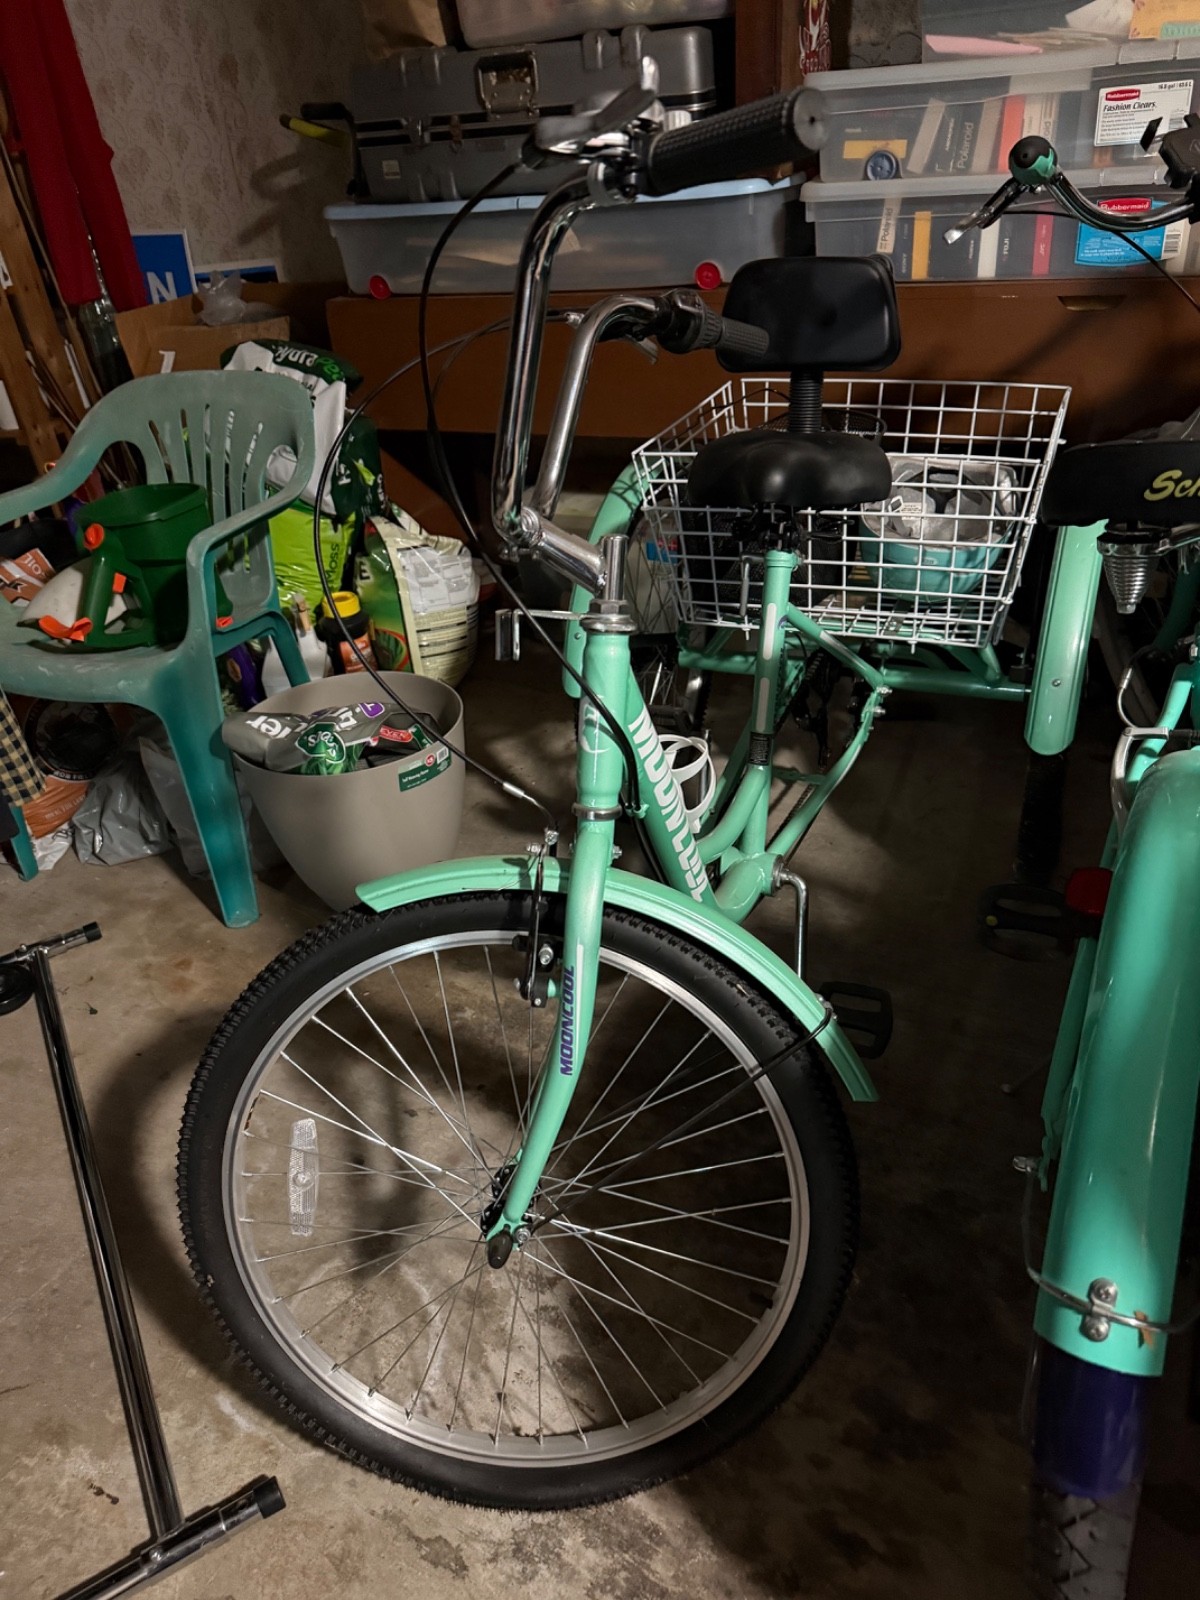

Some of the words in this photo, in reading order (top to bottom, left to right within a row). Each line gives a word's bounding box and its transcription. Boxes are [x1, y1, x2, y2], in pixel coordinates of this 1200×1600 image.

[1103, 103, 1132, 112] Fashion
[957, 121, 974, 169] Polaroid
[1100, 201, 1150, 211] Rubbermaid
[881, 207, 894, 242] Polaroid
[560, 965, 575, 1076] MOONCOOL
